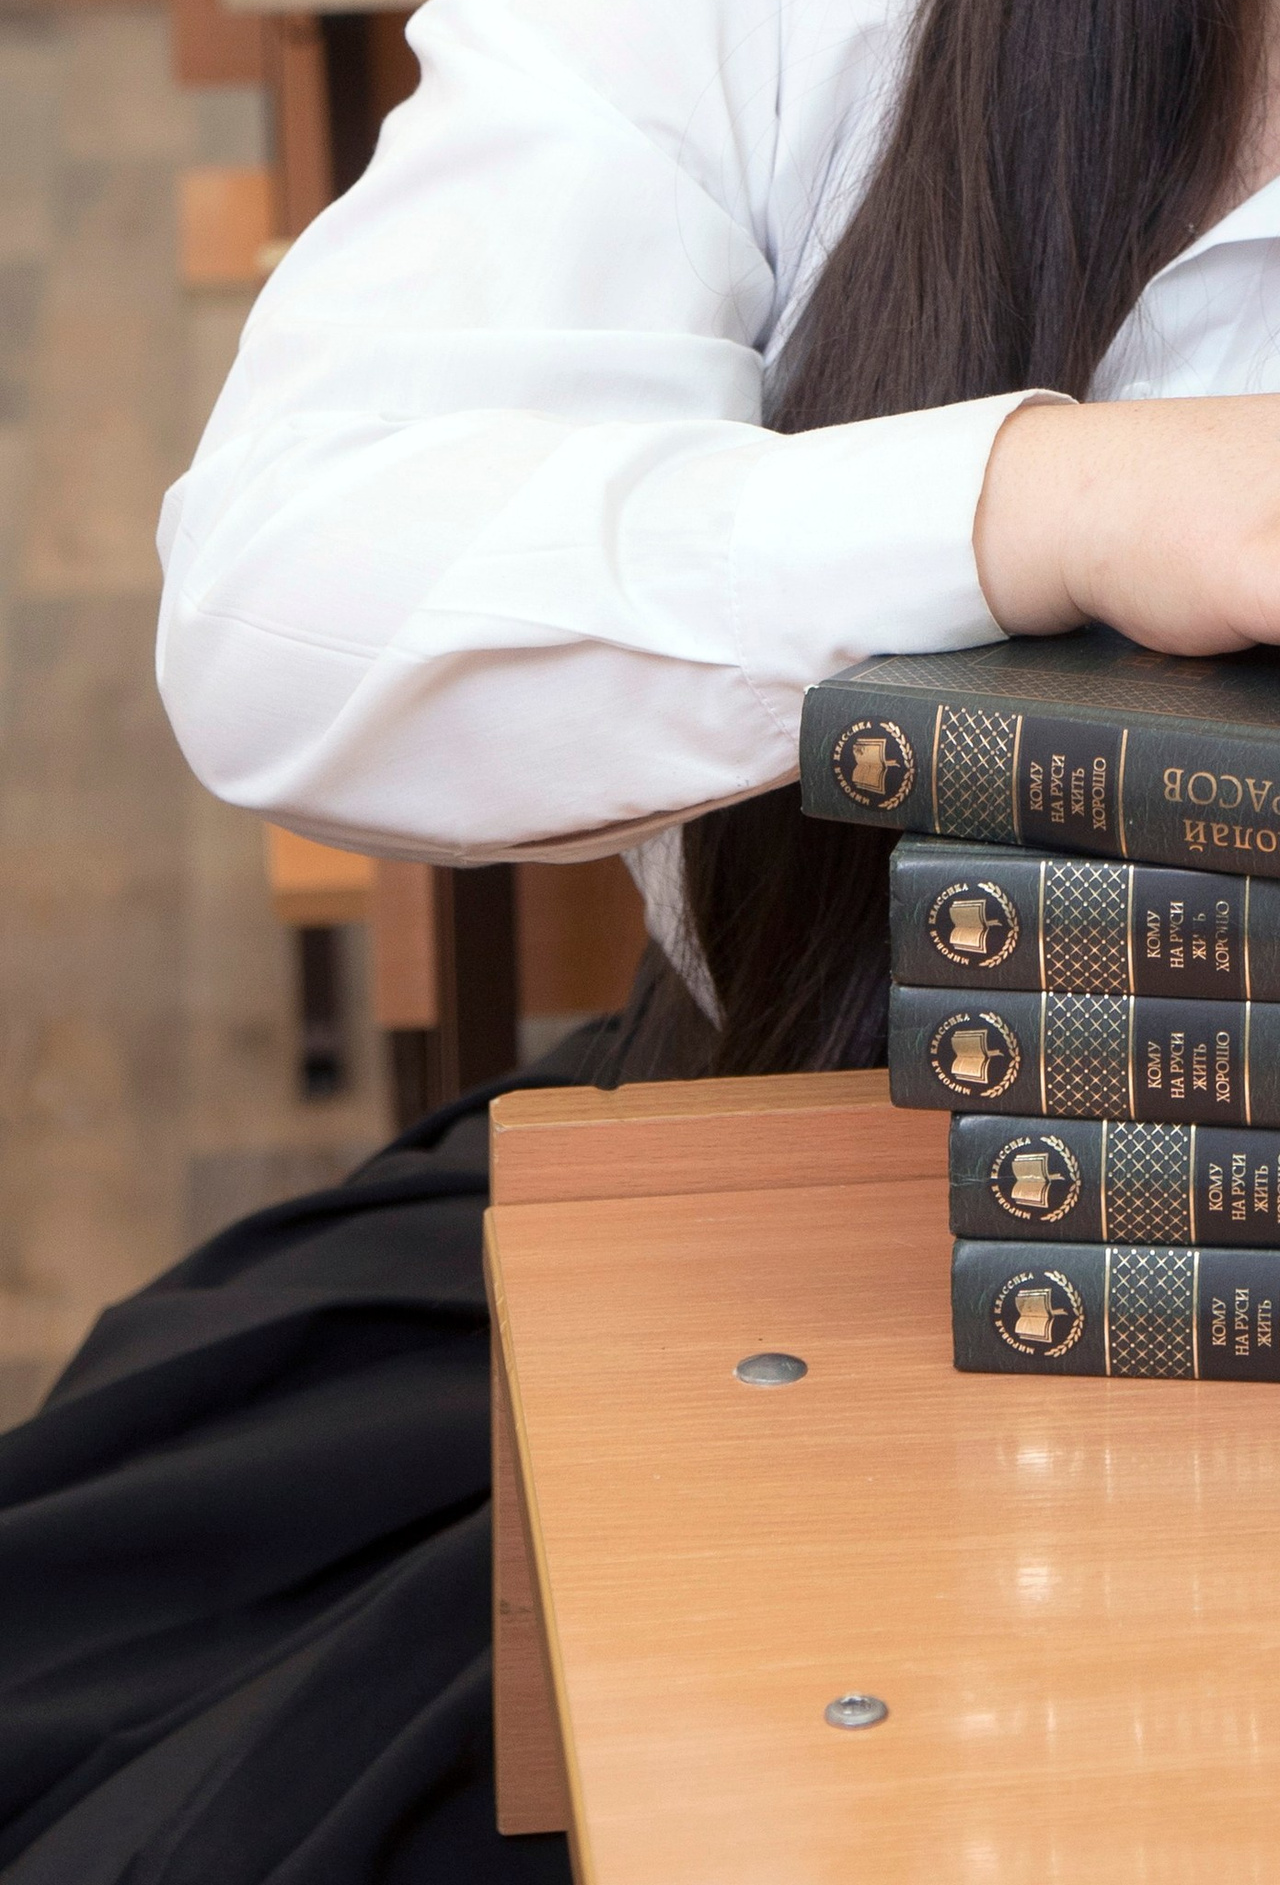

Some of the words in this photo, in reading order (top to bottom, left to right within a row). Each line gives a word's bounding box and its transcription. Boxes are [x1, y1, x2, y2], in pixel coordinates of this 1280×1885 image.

[832, 720, 873, 762] КЛАССИКА
[832, 767, 872, 806] МИРОВАЯ
[1029, 761, 1044, 812] КОМУ
[1051, 754, 1066, 797] РУСИ
[1071, 767, 1086, 817] ЖИТЬ
[1092, 757, 1108, 831] ХОРОШО
[1051, 802, 1066, 824] НА
[928, 882, 970, 925] КЛАССИКА
[1170, 900, 1185, 942] РУСИ
[929, 930, 970, 966] МИРОВАЯ
[1146, 910, 1161, 958] КОМУ
[1192, 912, 1207, 960] ЖИЬ
[1170, 946, 1185, 968] НА
[930, 1013, 971, 1055] КЛАССИКА
[1170, 1031, 1185, 1073] РУСИ
[930, 1061, 972, 1096] МИРОВАЯ
[1147, 1041, 1162, 1089] КОМУ
[1192, 1043, 1207, 1091] ЖИТЬ
[1215, 1031, 1230, 1103] ХОРОШО
[1170, 1077, 1185, 1099] НА
[990, 1136, 1032, 1179] КЛАССИКА
[1231, 1153, 1246, 1195] РУСИ
[990, 1184, 1032, 1221] МИРОВАЯ
[1208, 1162, 1223, 1212] КОМУ
[1254, 1164, 1268, 1213] ЖИТЬ
[1231, 1199, 1246, 1221] НА
[993, 1272, 1035, 1315] КЛАССИКА
[1235, 1288, 1250, 1330] РУСИ
[994, 1319, 1035, 1355] МИРОВАЯ
[1211, 1298, 1227, 1347] КОМУ
[1257, 1299, 1271, 1348] ЖИТЬ
[1235, 1334, 1250, 1356] НА
